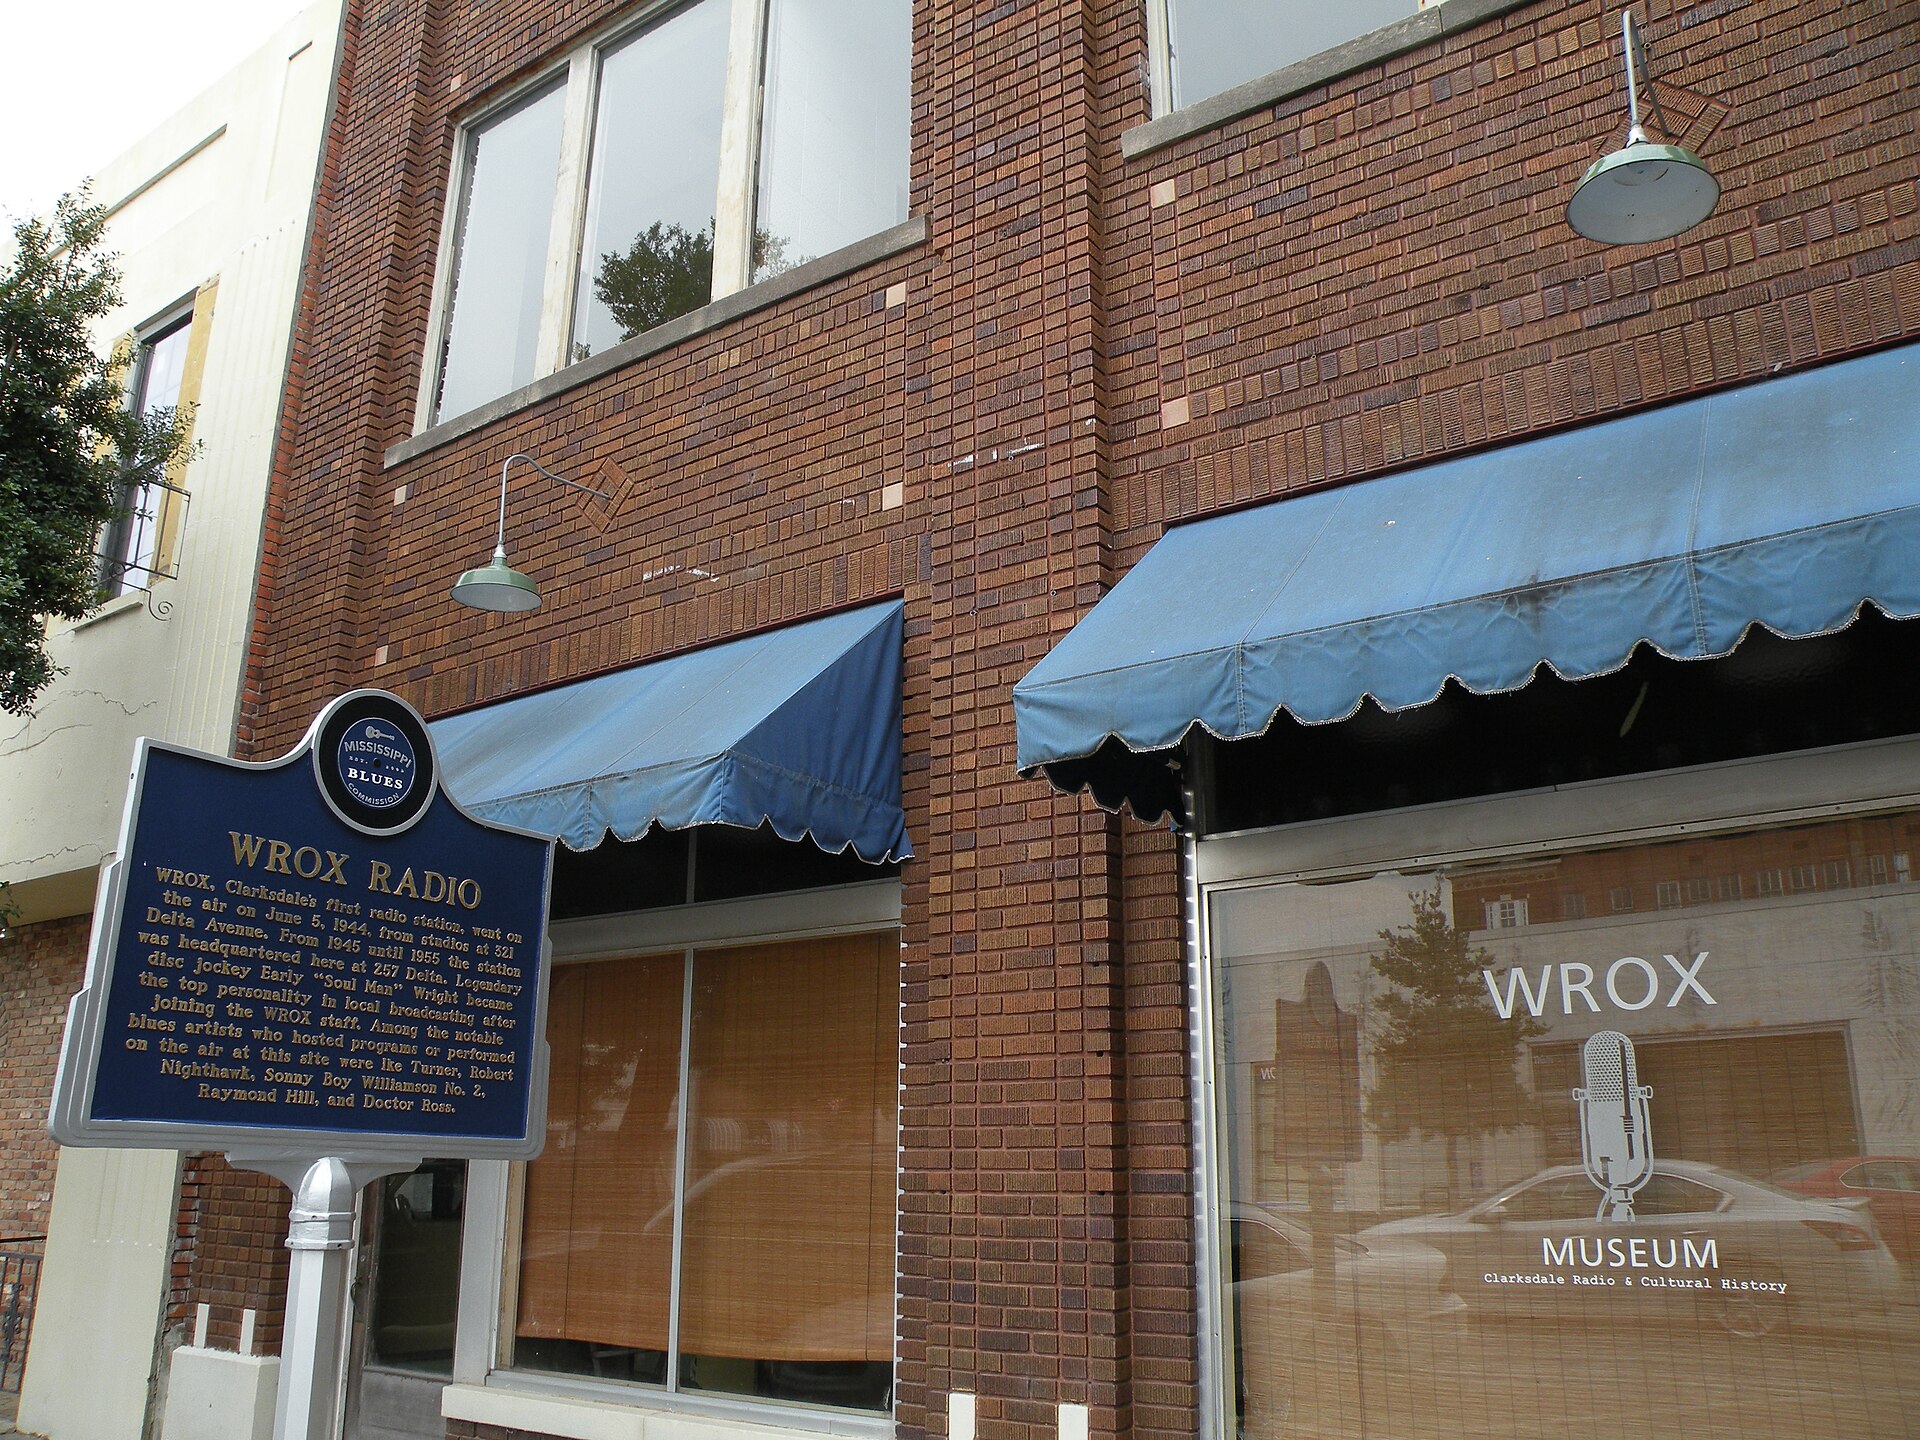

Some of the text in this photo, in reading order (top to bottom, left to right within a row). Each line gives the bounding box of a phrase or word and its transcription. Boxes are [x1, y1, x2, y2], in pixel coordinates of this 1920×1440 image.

[344, 740, 413, 768] MISSISSIPPI
[348, 768, 403, 790] BLUES
[348, 782, 400, 805] COMMISSION
[228, 831, 482, 910] WROX RADIO
[156, 866, 522, 944] WROX, Clarksdale's first radio station, went on
[163, 889, 514, 960] the air on June 5, 1944, from studios at 321
[138, 931, 522, 996] was headquartered here at 257 Delta. Legendary
[146, 906, 522, 978] Delta Avenue. From 1945 until 1955 the station
[138, 970, 516, 1030] the top personality in local broadcasting after
[148, 950, 185, 970] disc
[193, 956, 252, 980] jockey
[260, 965, 304, 986] Early
[414, 986, 458, 1005] Wright
[466, 993, 513, 1012] became
[1483, 952, 1718, 1019] WROX
[128, 1013, 516, 1064] blues artists who hosted programs or performed
[150, 994, 504, 1046] joining the WROX staff. Among the notable
[125, 1037, 514, 1082] on the air at this site were Ike Turner, Robert
[160, 1058, 486, 1099] Nighthawk, Sonny Boy Williamson No. 2,
[198, 1083, 456, 1113] Raymond Hill, and Doctor Ross.
[1542, 1237, 1719, 1269] MUSEUM
[1484, 1273, 1787, 1294] Clarksdale Radio & Cultural History
